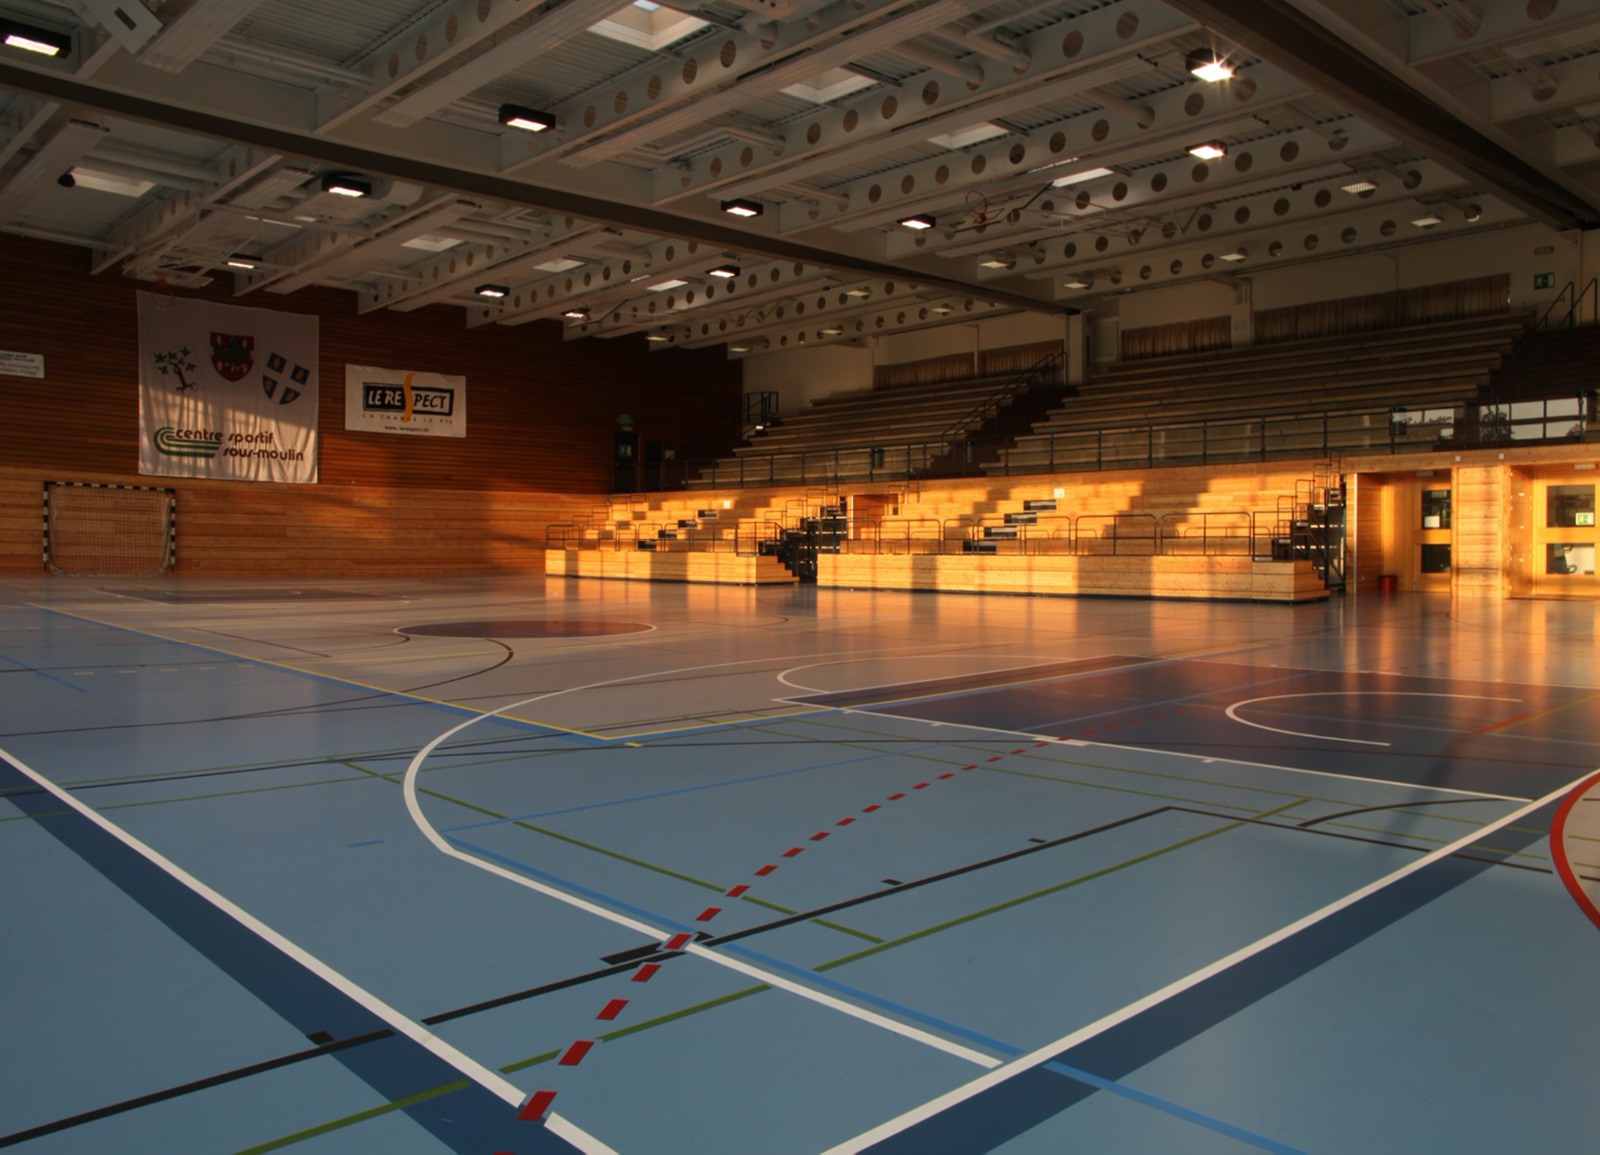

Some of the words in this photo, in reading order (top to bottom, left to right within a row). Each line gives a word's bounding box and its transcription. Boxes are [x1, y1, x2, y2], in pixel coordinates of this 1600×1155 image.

[368, 391, 381, 404] LE
[176, 429, 224, 441] centre
[228, 432, 273, 444] sportif
[223, 448, 303, 460] sous-moulin
